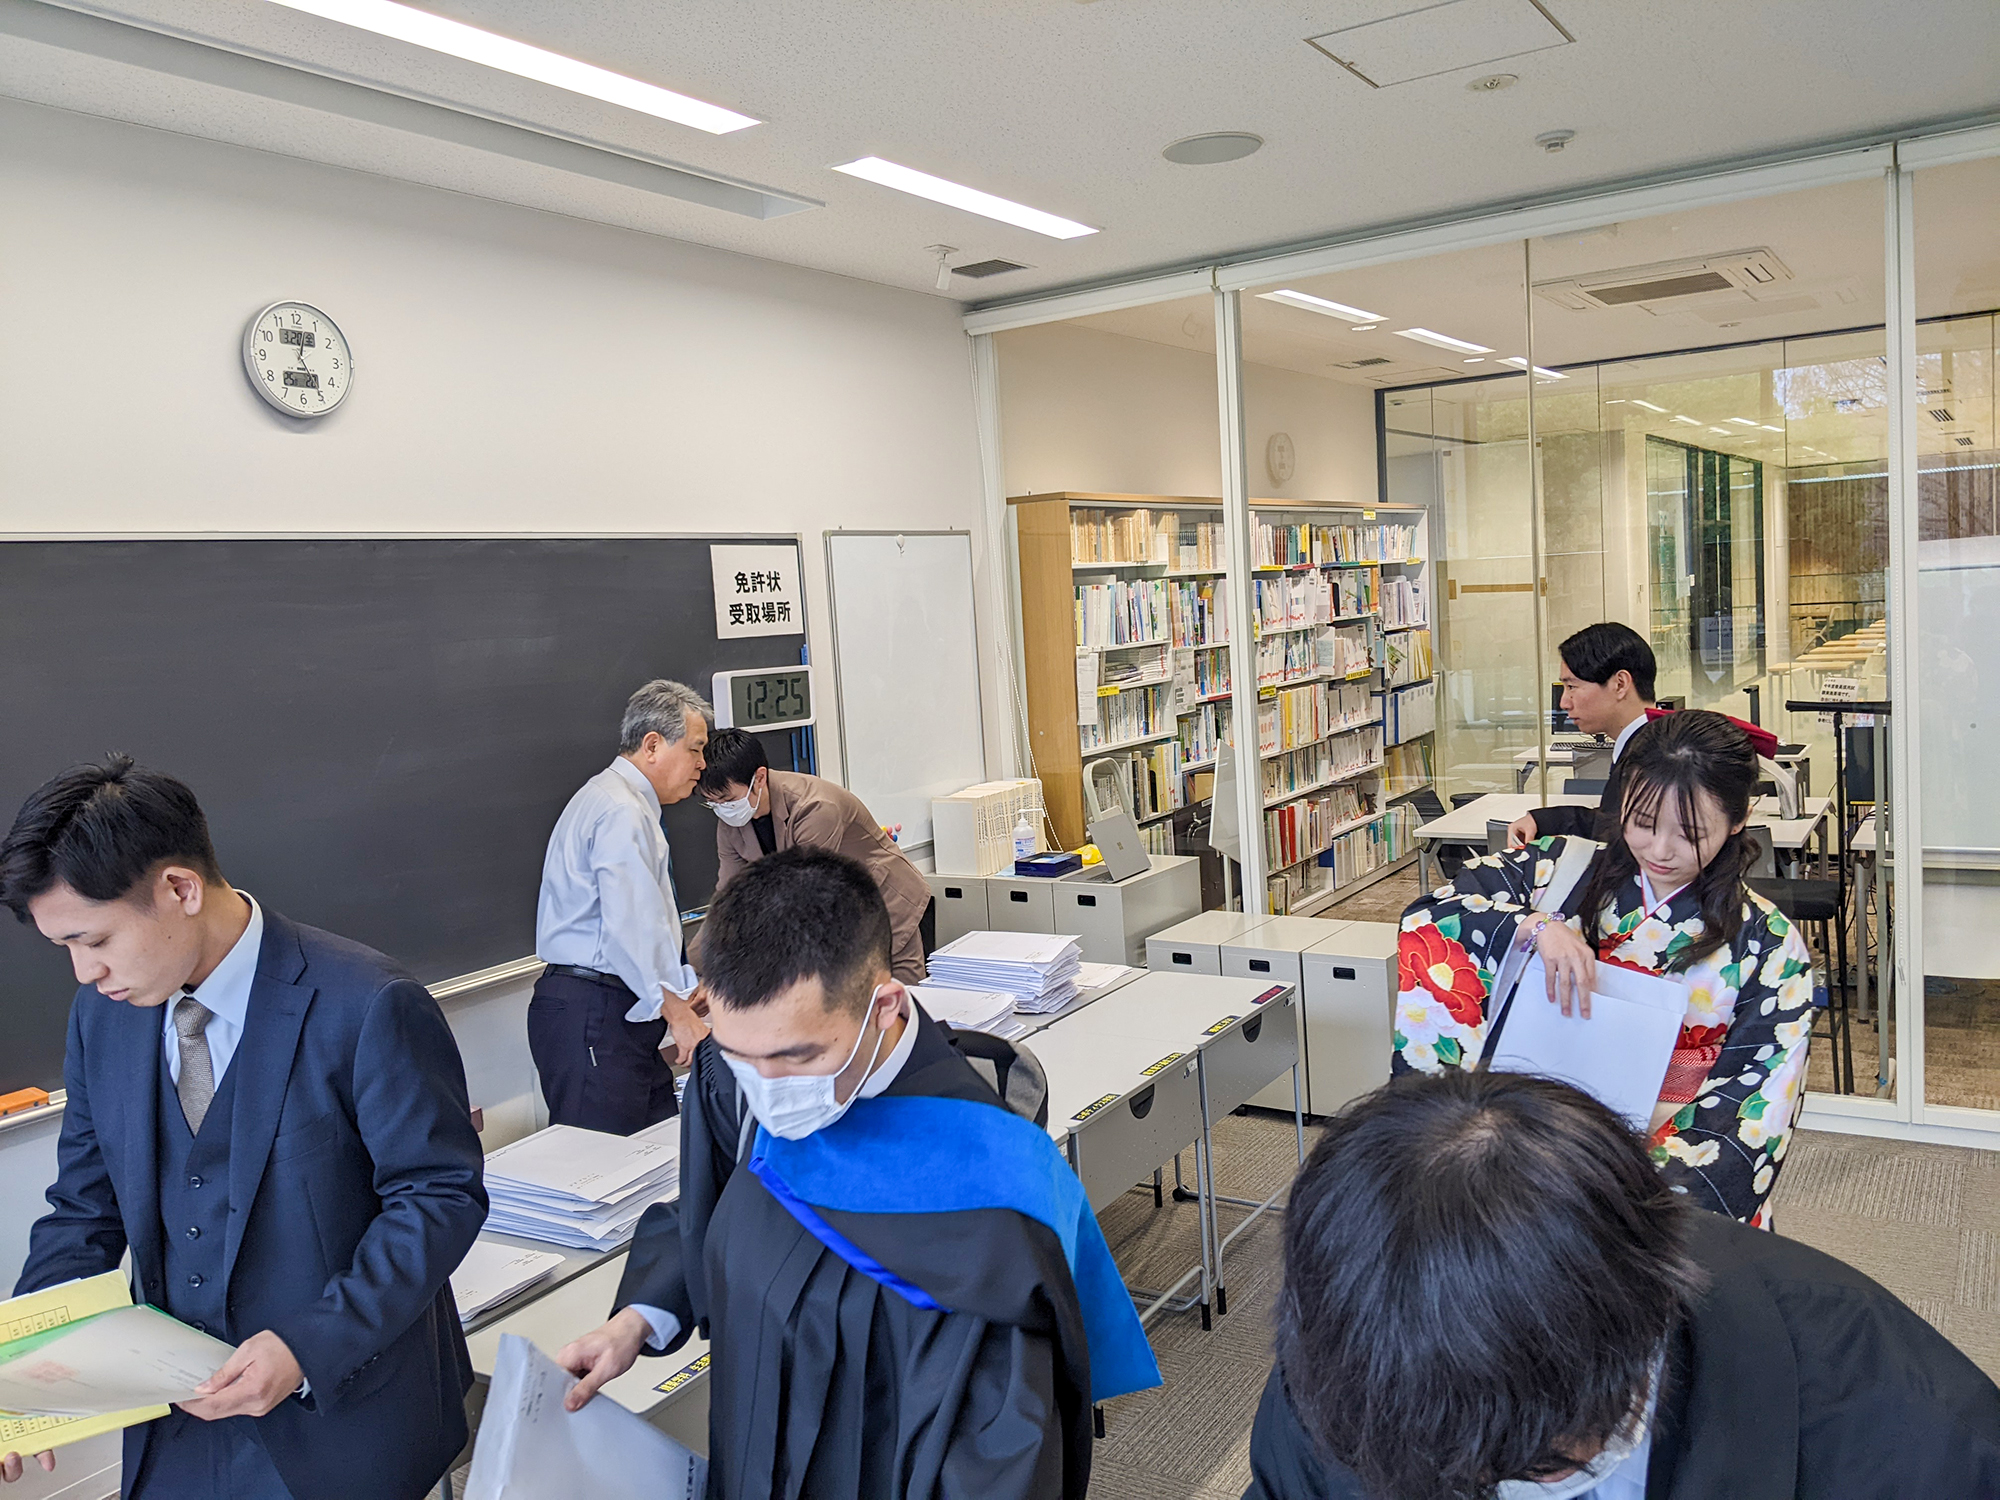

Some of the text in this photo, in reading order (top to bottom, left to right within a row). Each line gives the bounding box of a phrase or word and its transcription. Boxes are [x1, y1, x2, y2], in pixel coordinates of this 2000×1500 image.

[274, 315, 283, 328] 11
[291, 313, 302, 326] 12
[262, 330, 273, 342] 10
[324, 338, 332, 350] 2
[258, 349, 266, 360] 9
[332, 358, 340, 370] 3
[266, 370, 274, 382] 8
[328, 376, 335, 388] 4
[282, 386, 288, 398] 7
[318, 391, 324, 402] 5
[300, 394, 308, 404] 6
[734, 571, 782, 594] 免許状
[729, 601, 791, 626] 受取場所
[747, 678, 804, 720] 12:25
